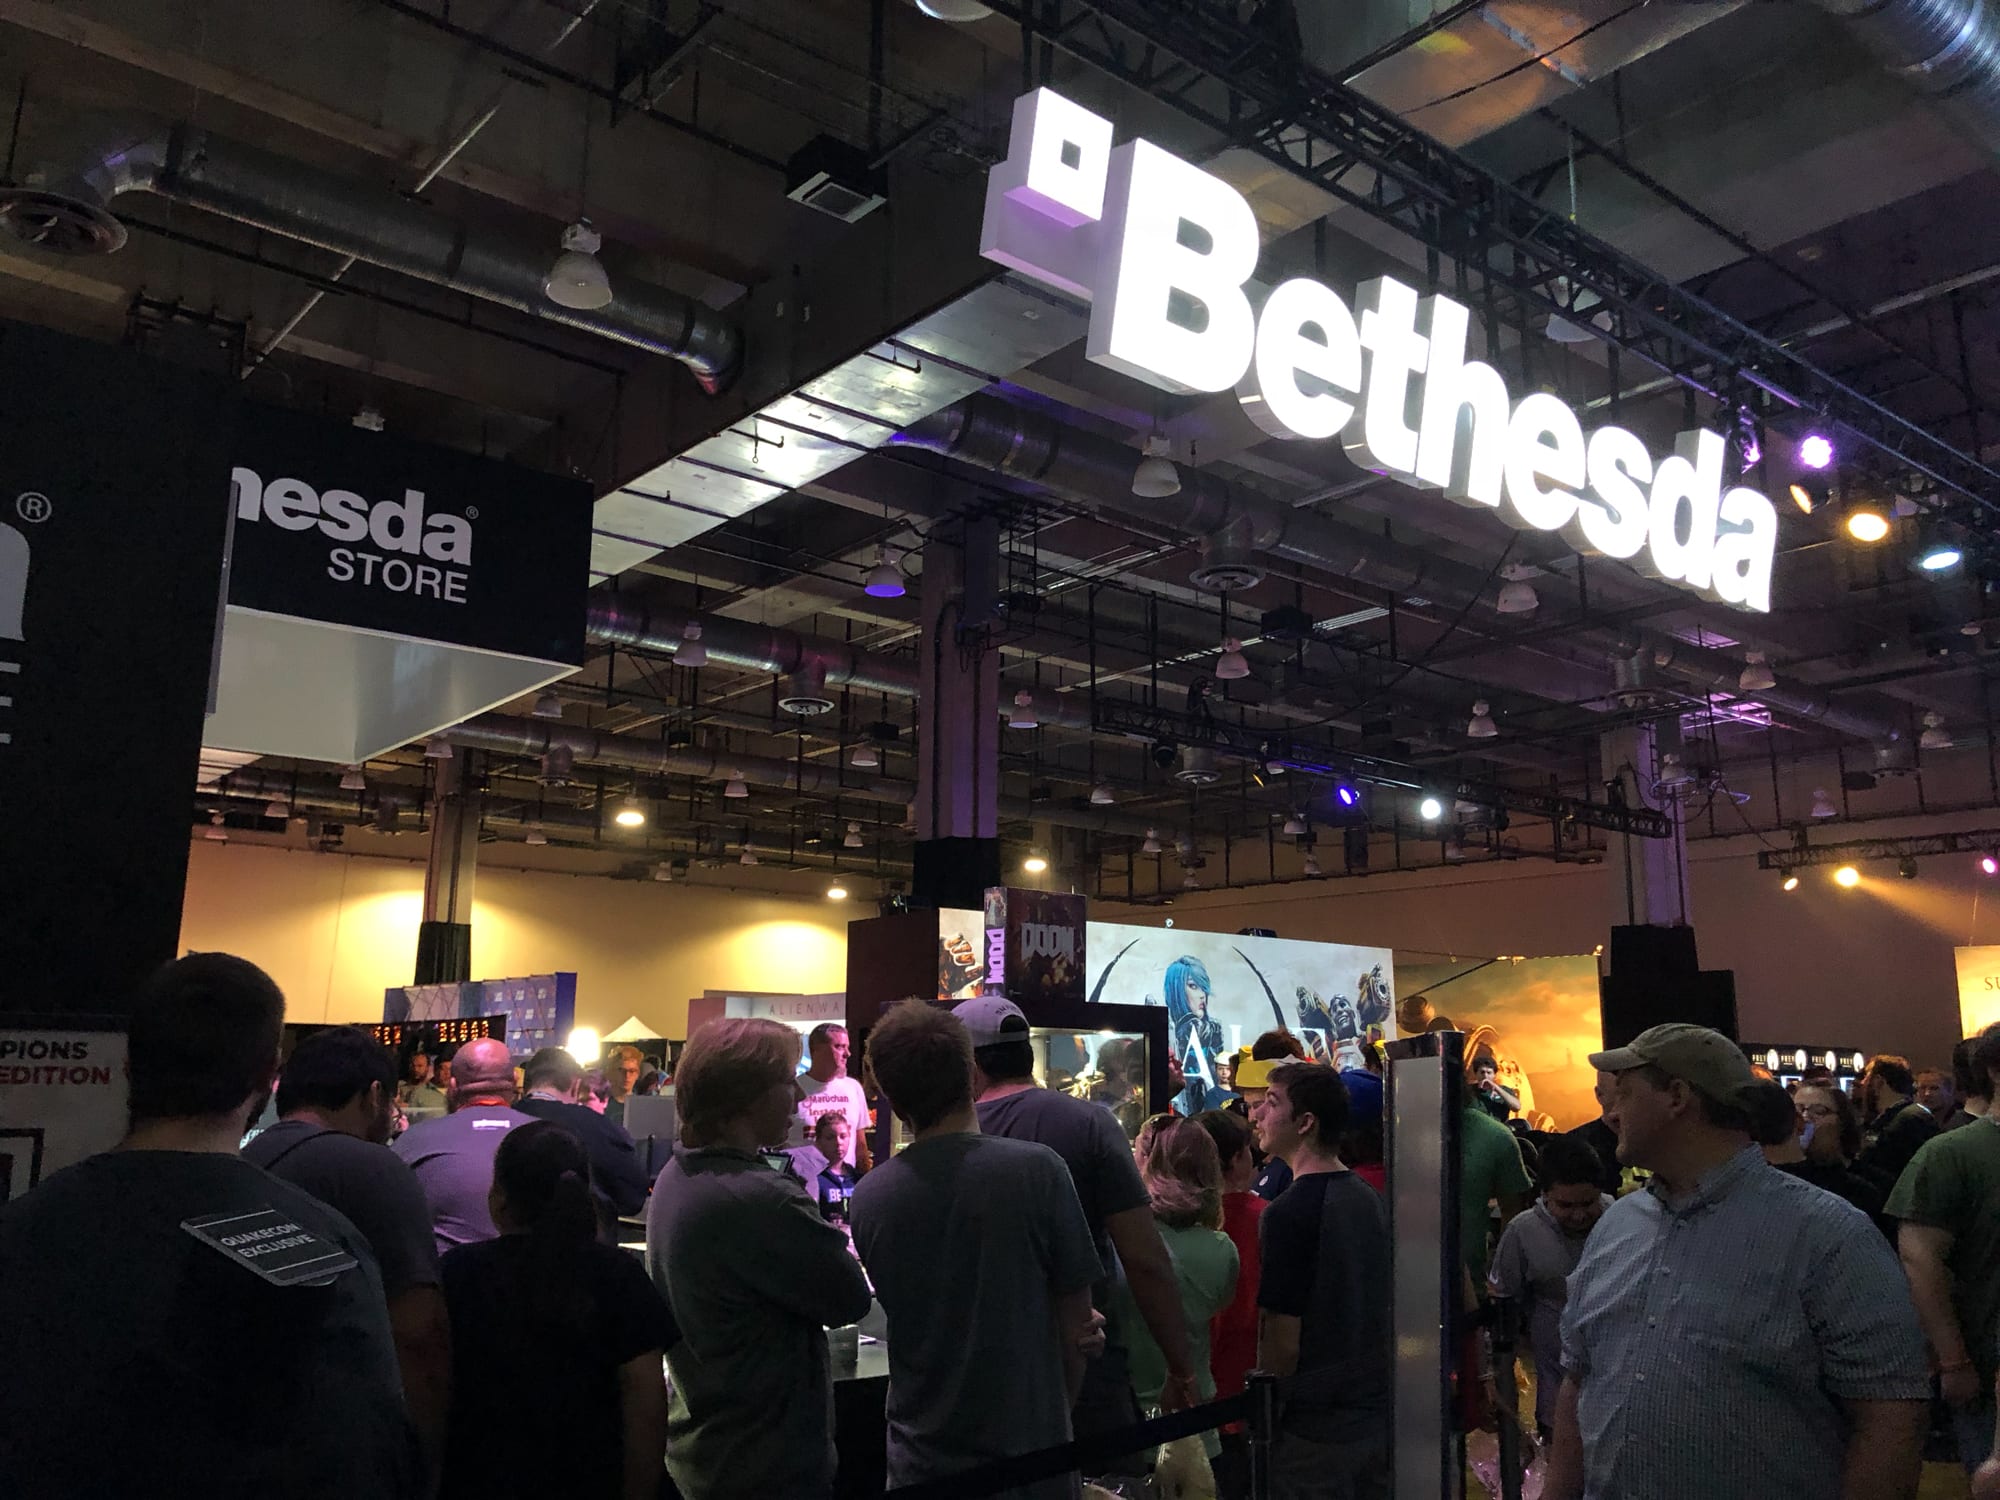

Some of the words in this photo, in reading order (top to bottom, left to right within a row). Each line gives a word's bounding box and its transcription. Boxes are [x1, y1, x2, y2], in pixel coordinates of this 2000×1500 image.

[1088, 136, 1778, 613] Bethesda
[327, 547, 469, 604] STORE
[984, 927, 1006, 985] DOOM
[1021, 922, 1076, 966] DOOM
[0, 1040, 88, 1060] PIONS
[220, 1222, 302, 1247] QUAKECON
[237, 1233, 317, 1258] EXCLUSIVE
